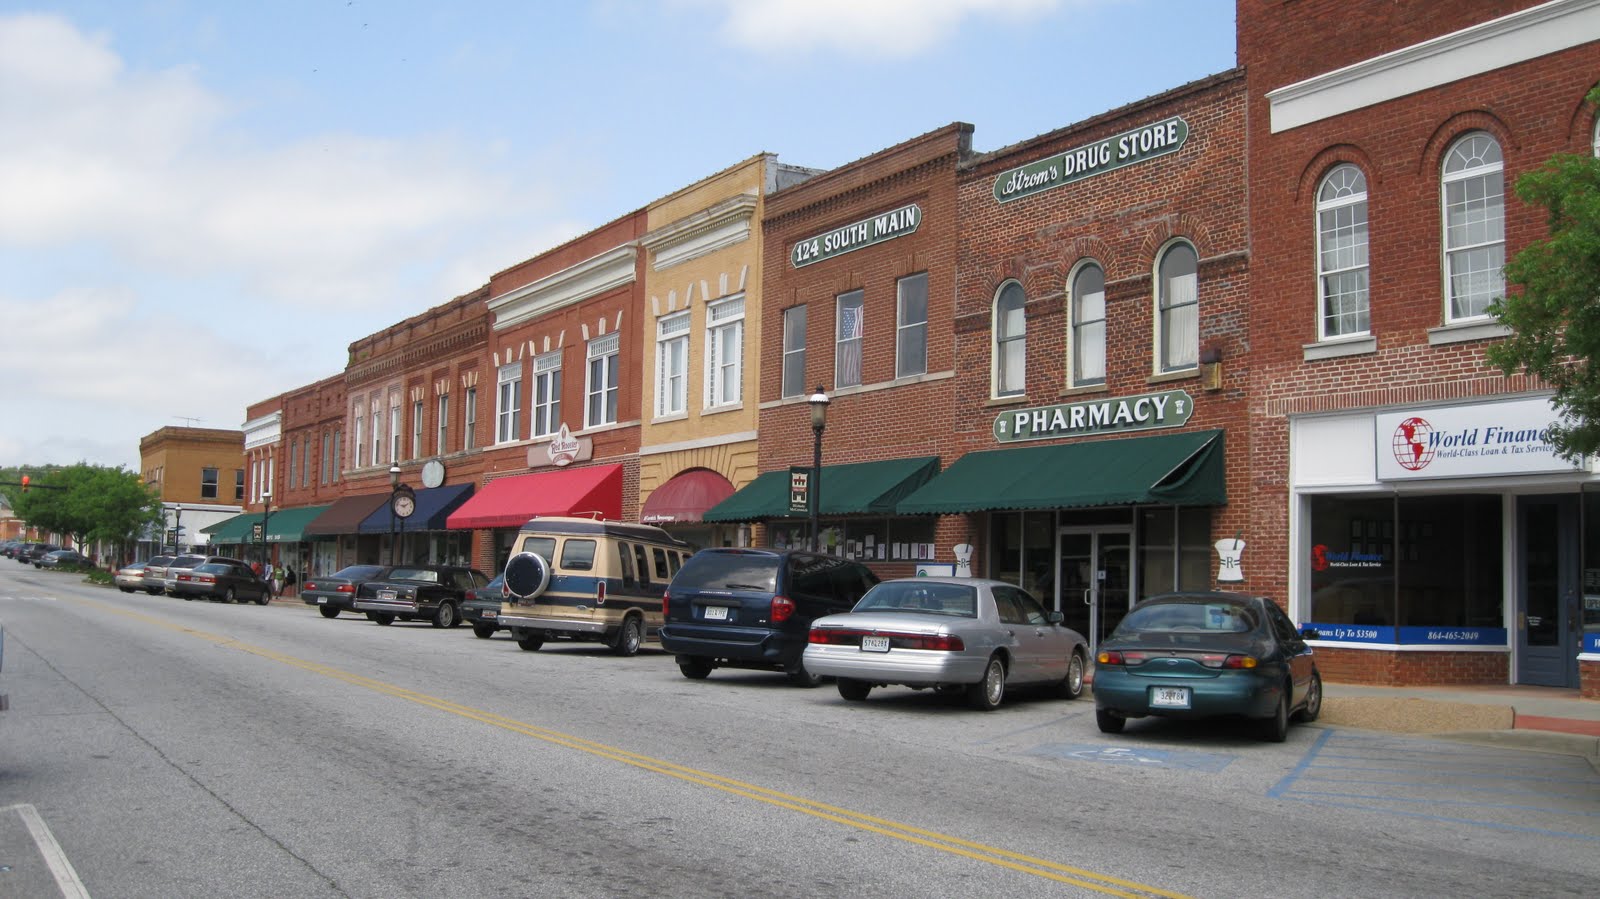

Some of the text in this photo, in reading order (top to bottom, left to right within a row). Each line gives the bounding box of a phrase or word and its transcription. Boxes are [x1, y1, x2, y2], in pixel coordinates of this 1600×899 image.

[1002, 120, 1178, 195] Strom's DRUG STORE
[796, 207, 915, 262] 124 SOUTH MAIN
[1014, 395, 1170, 433] PHARMACY
[1428, 428, 1478, 448] World
[1437, 447, 1479, 459] World-Class
[1480, 447, 1499, 456] Loan
[1511, 445, 1524, 454] Tax
[1526, 443, 1554, 453] Service
[1226, 556, 1234, 569] R
[1335, 628, 1345, 639] Up
[1346, 629, 1355, 638] To
[1356, 629, 1377, 639] $3500
